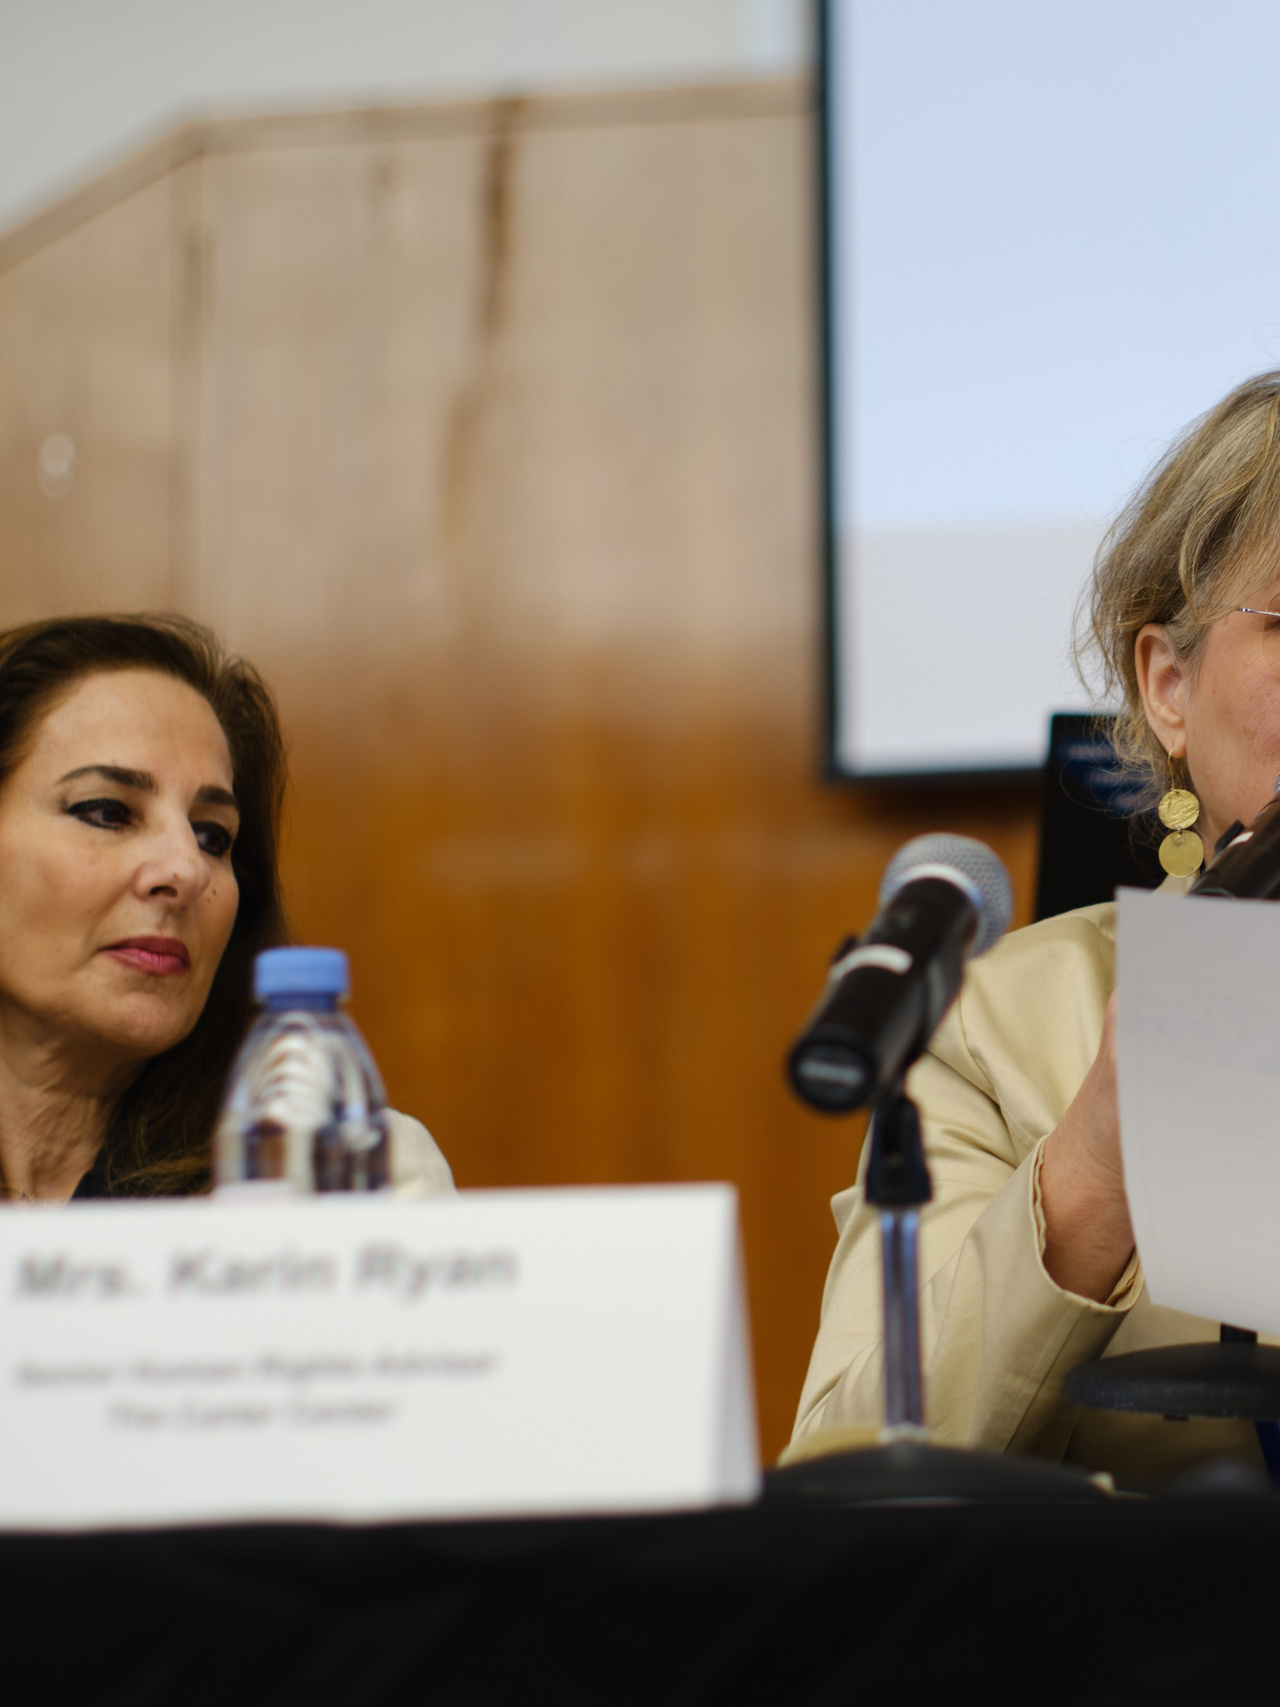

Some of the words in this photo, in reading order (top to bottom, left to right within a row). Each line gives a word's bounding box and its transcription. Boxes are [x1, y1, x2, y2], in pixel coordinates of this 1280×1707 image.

[10, 1250, 156, 1302] Mrs.
[163, 1243, 343, 1297] Karin
[348, 1239, 524, 1304] Ryan
